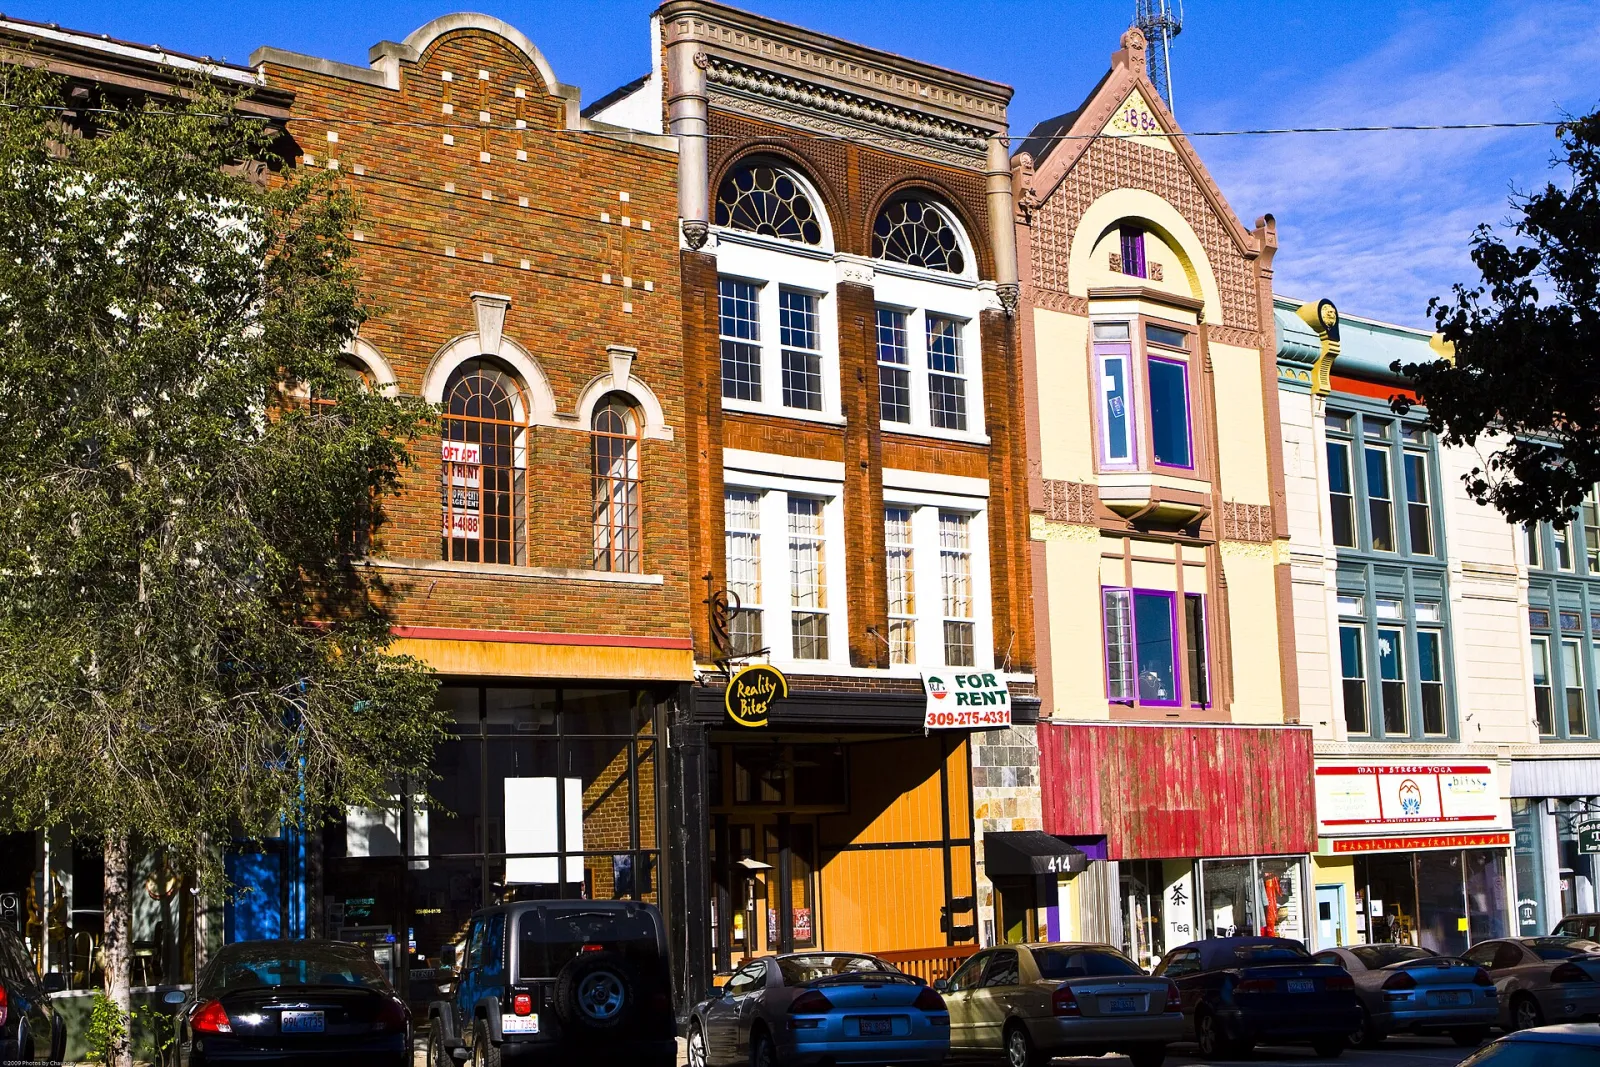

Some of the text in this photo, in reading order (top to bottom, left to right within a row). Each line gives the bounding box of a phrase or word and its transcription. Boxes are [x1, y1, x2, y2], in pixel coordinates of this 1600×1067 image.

[1124, 108, 1156, 130] 1884
[442, 446, 459, 460] OFT
[737, 674, 776, 703] Reality
[955, 673, 998, 688] FOR
[955, 690, 1007, 706] RENT
[740, 698, 767, 718] Bites
[927, 711, 1010, 726] 309-275-4331
[1427, 766, 1452, 774] YOGA
[1048, 856, 1071, 872] 414
[1170, 883, 1188, 906] 茶
[1171, 922, 1190, 935] Tea
